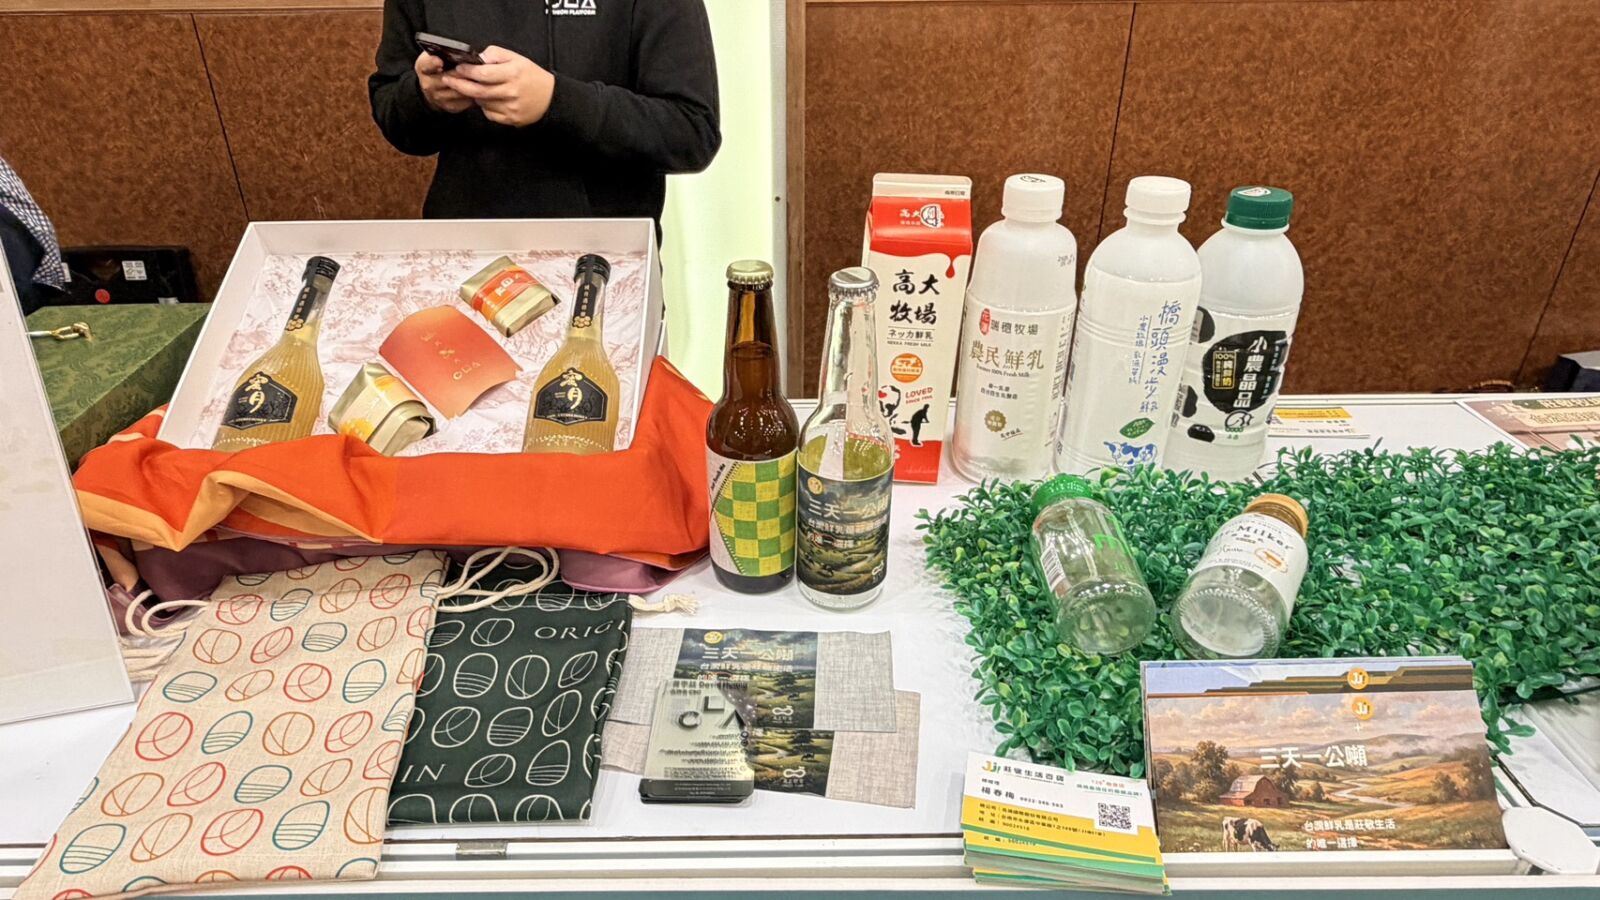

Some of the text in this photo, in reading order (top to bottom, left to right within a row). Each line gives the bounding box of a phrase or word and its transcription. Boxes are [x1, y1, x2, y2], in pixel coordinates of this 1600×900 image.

[893, 268, 940, 295] 高大
[889, 299, 937, 325] 牧場
[905, 386, 934, 399] LOVED
[1259, 745, 1368, 768] 三天一公噸
